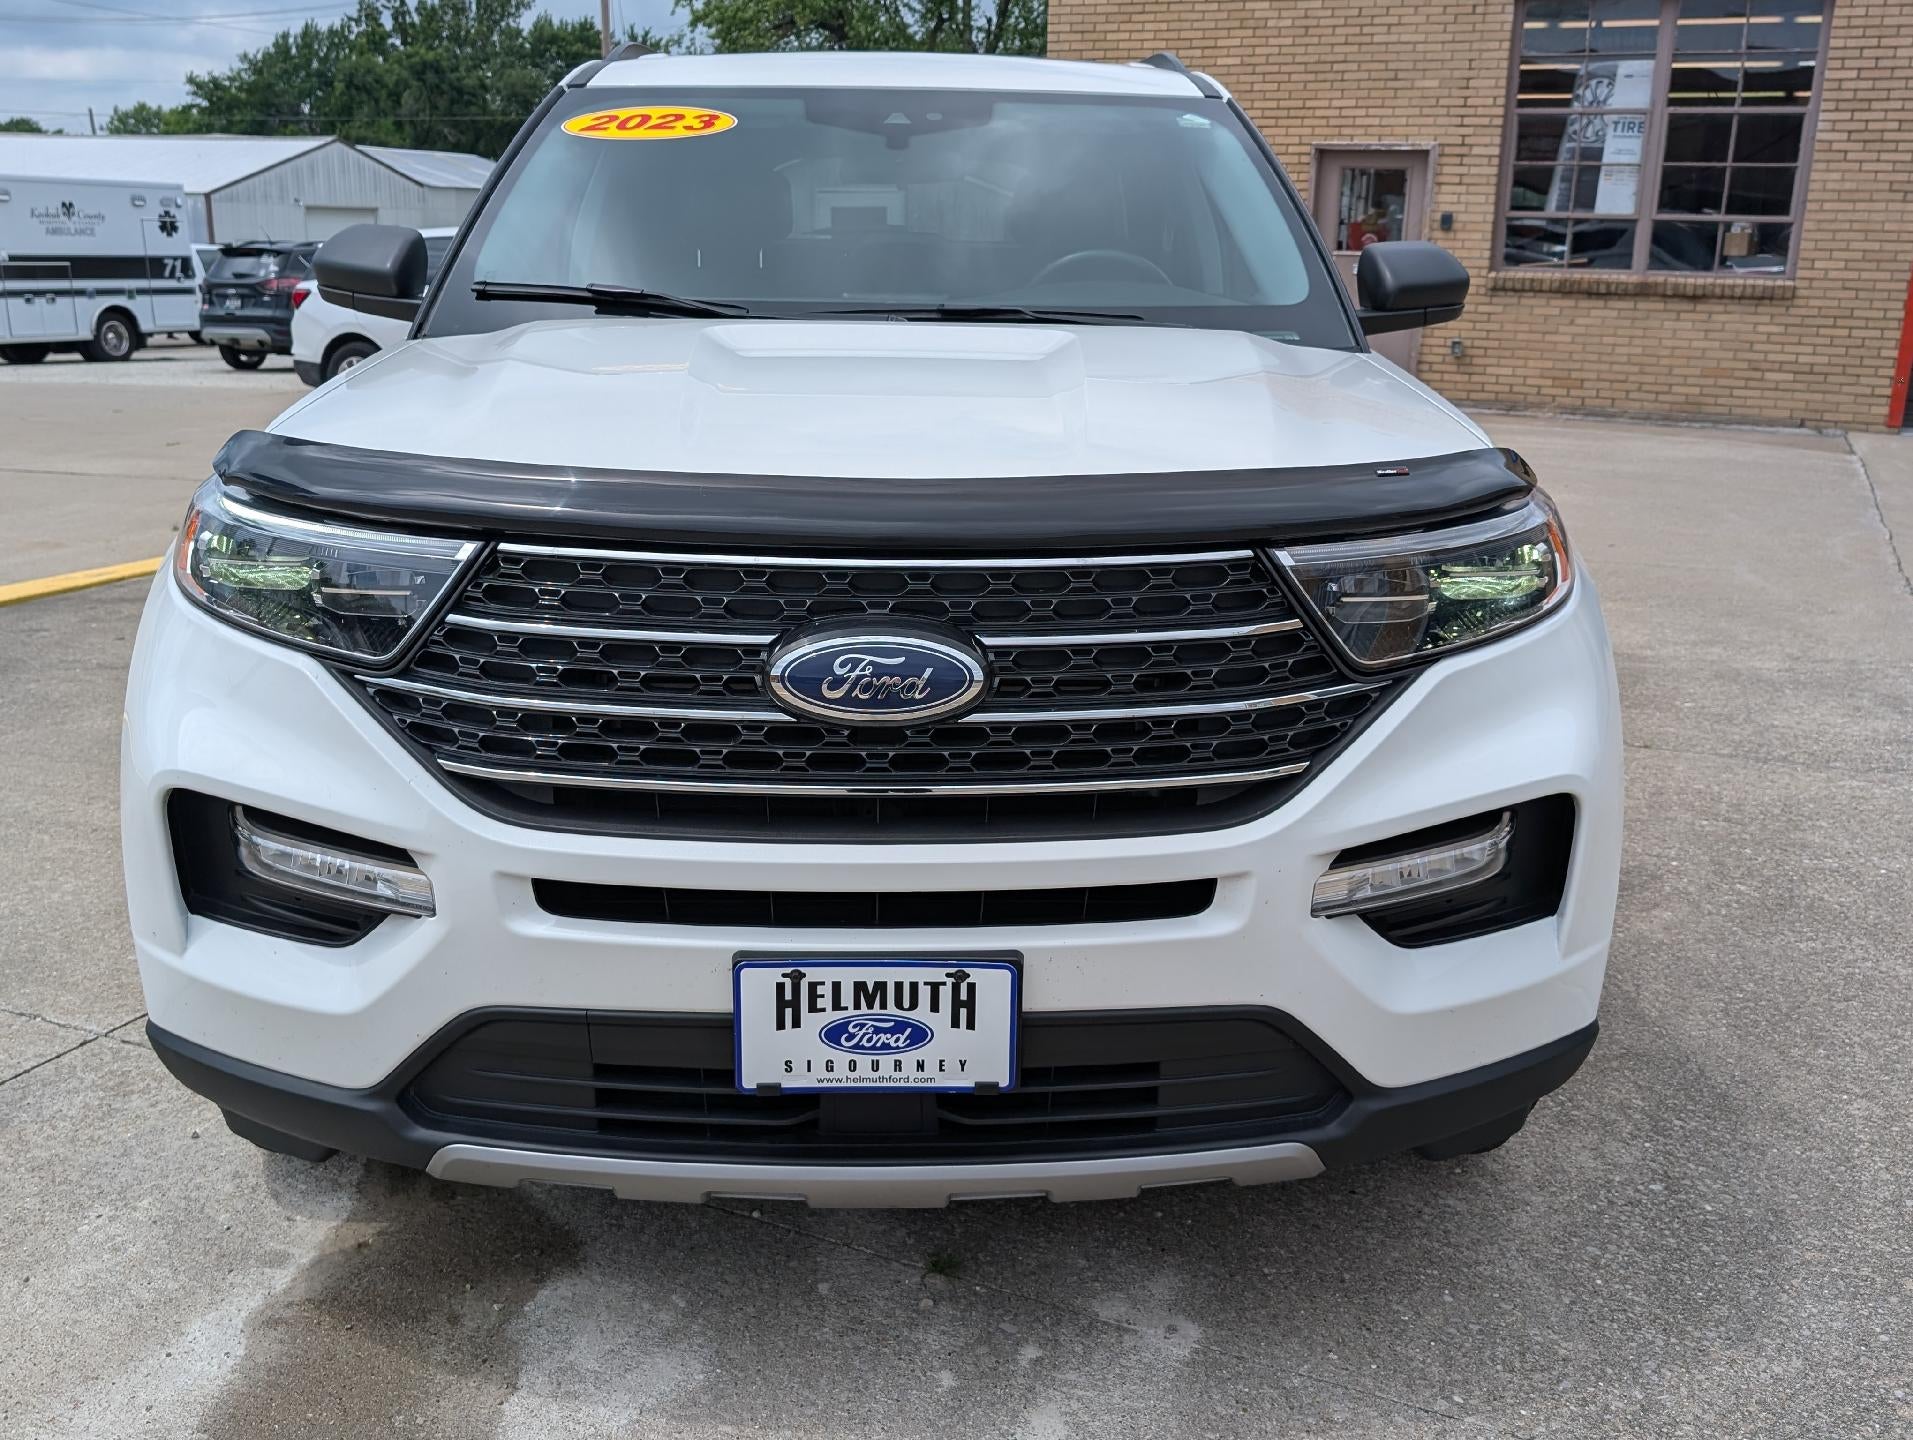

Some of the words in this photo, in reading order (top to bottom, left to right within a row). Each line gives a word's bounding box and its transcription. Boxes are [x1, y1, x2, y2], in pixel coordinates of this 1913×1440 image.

[577, 113, 721, 132] 2023
[1612, 120, 1646, 134] TIRE
[77, 208, 106, 223] County
[45, 226, 96, 237] AMBULANCE
[163, 258, 182, 278] 71
[821, 653, 934, 700] Ford
[775, 979, 977, 1031] HELMUTH
[840, 1018, 911, 1048] Ford
[783, 1058, 969, 1073] SIGOURNEY
[816, 1074, 936, 1085] www.helmuthford.com
